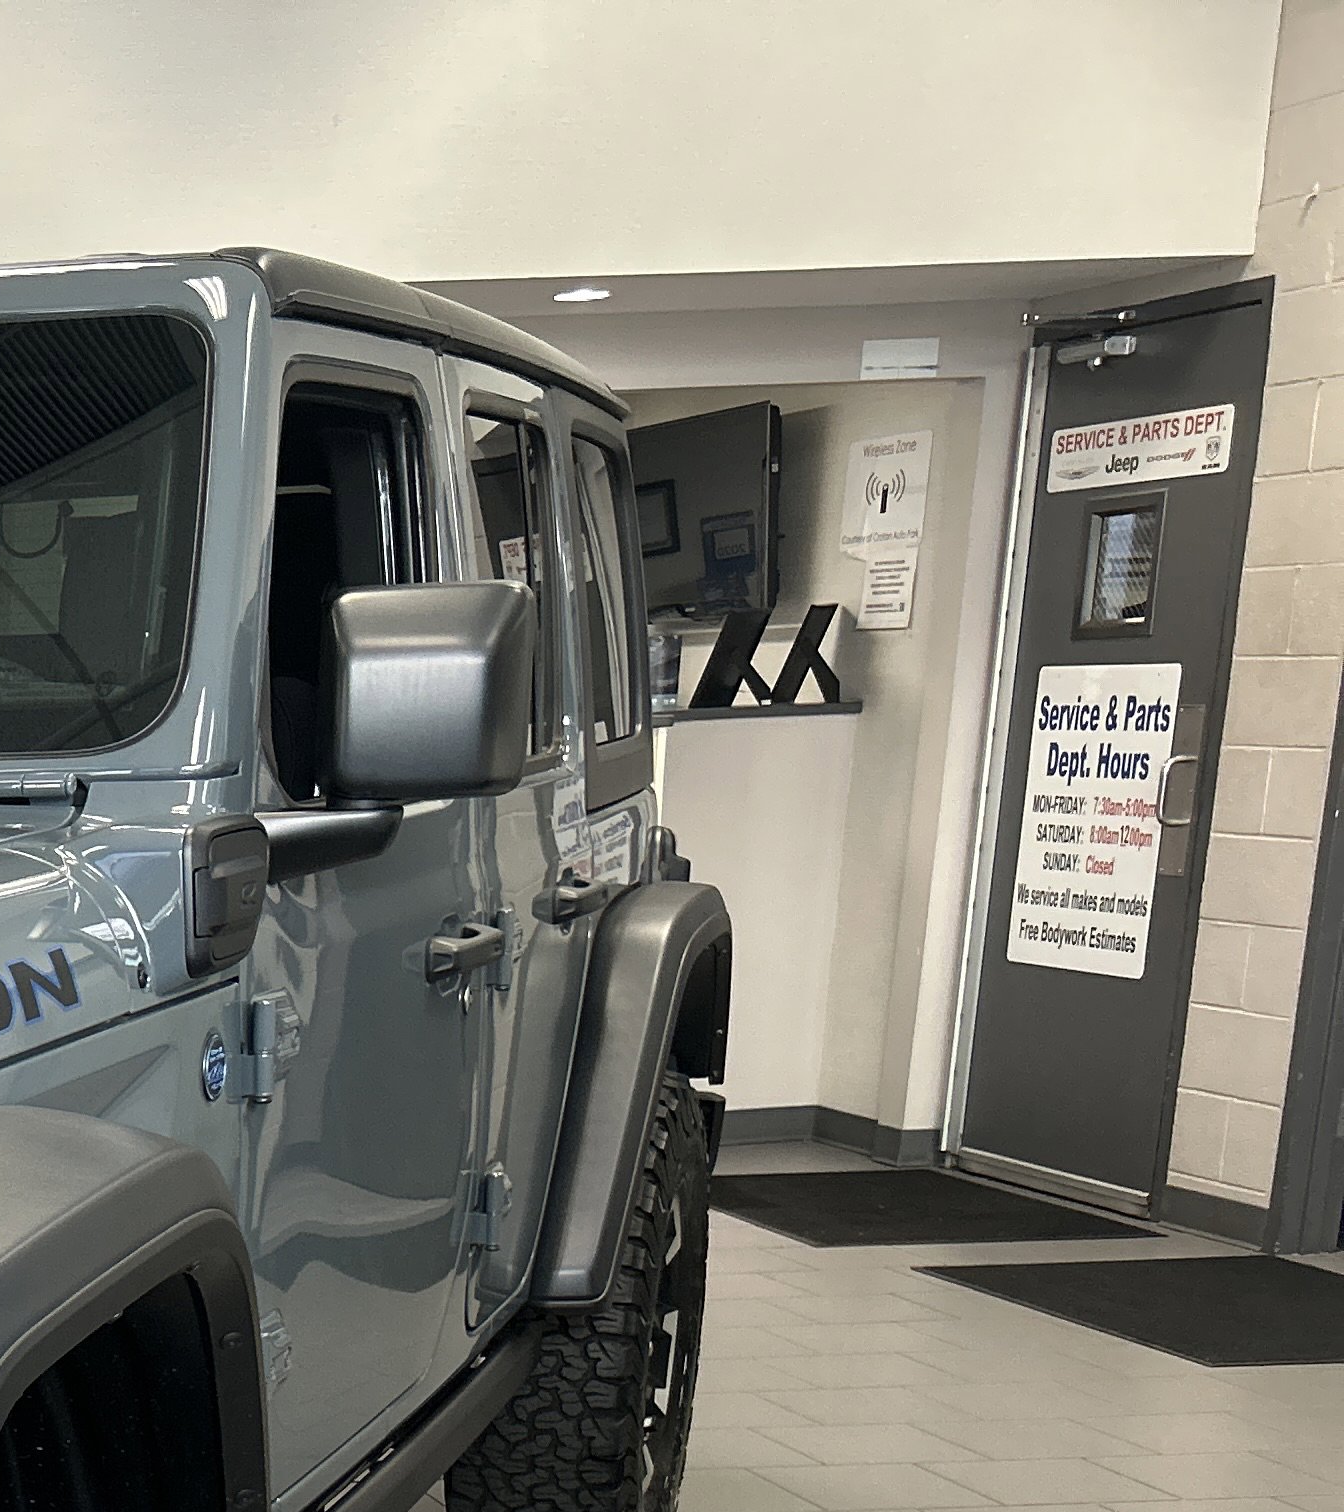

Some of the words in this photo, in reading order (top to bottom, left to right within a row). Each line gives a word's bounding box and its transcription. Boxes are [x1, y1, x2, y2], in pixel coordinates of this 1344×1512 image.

[1056, 427, 1115, 455] SERVICE
[1118, 425, 1128, 445] &
[1132, 417, 1180, 444] PARTS
[1183, 411, 1227, 438] DEPT.
[863, 442, 894, 458] Wireless
[895, 439, 917, 455] Zone
[1105, 454, 1139, 475] Jeep
[1038, 695, 1100, 731] Service
[1106, 694, 1118, 731] &
[1123, 695, 1172, 732] Parts
[1046, 742, 1090, 786] Dept.
[1096, 743, 1150, 780] Hours
[1032, 794, 1088, 816] MON-FRIDAY:
[1036, 823, 1085, 845] SATURDAY:
[1042, 851, 1081, 873] SUNDAY:
[1085, 855, 1115, 875] Closed
[1017, 882, 1030, 904] We
[1030, 886, 1059, 908] service
[1060, 888, 1070, 909] all
[1071, 890, 1098, 912] makes
[1099, 892, 1116, 913] and
[1116, 894, 1148, 918] models
[1018, 919, 1039, 942] Free
[1041, 921, 1087, 949] Bodywork
[1088, 926, 1137, 953] Estimates
